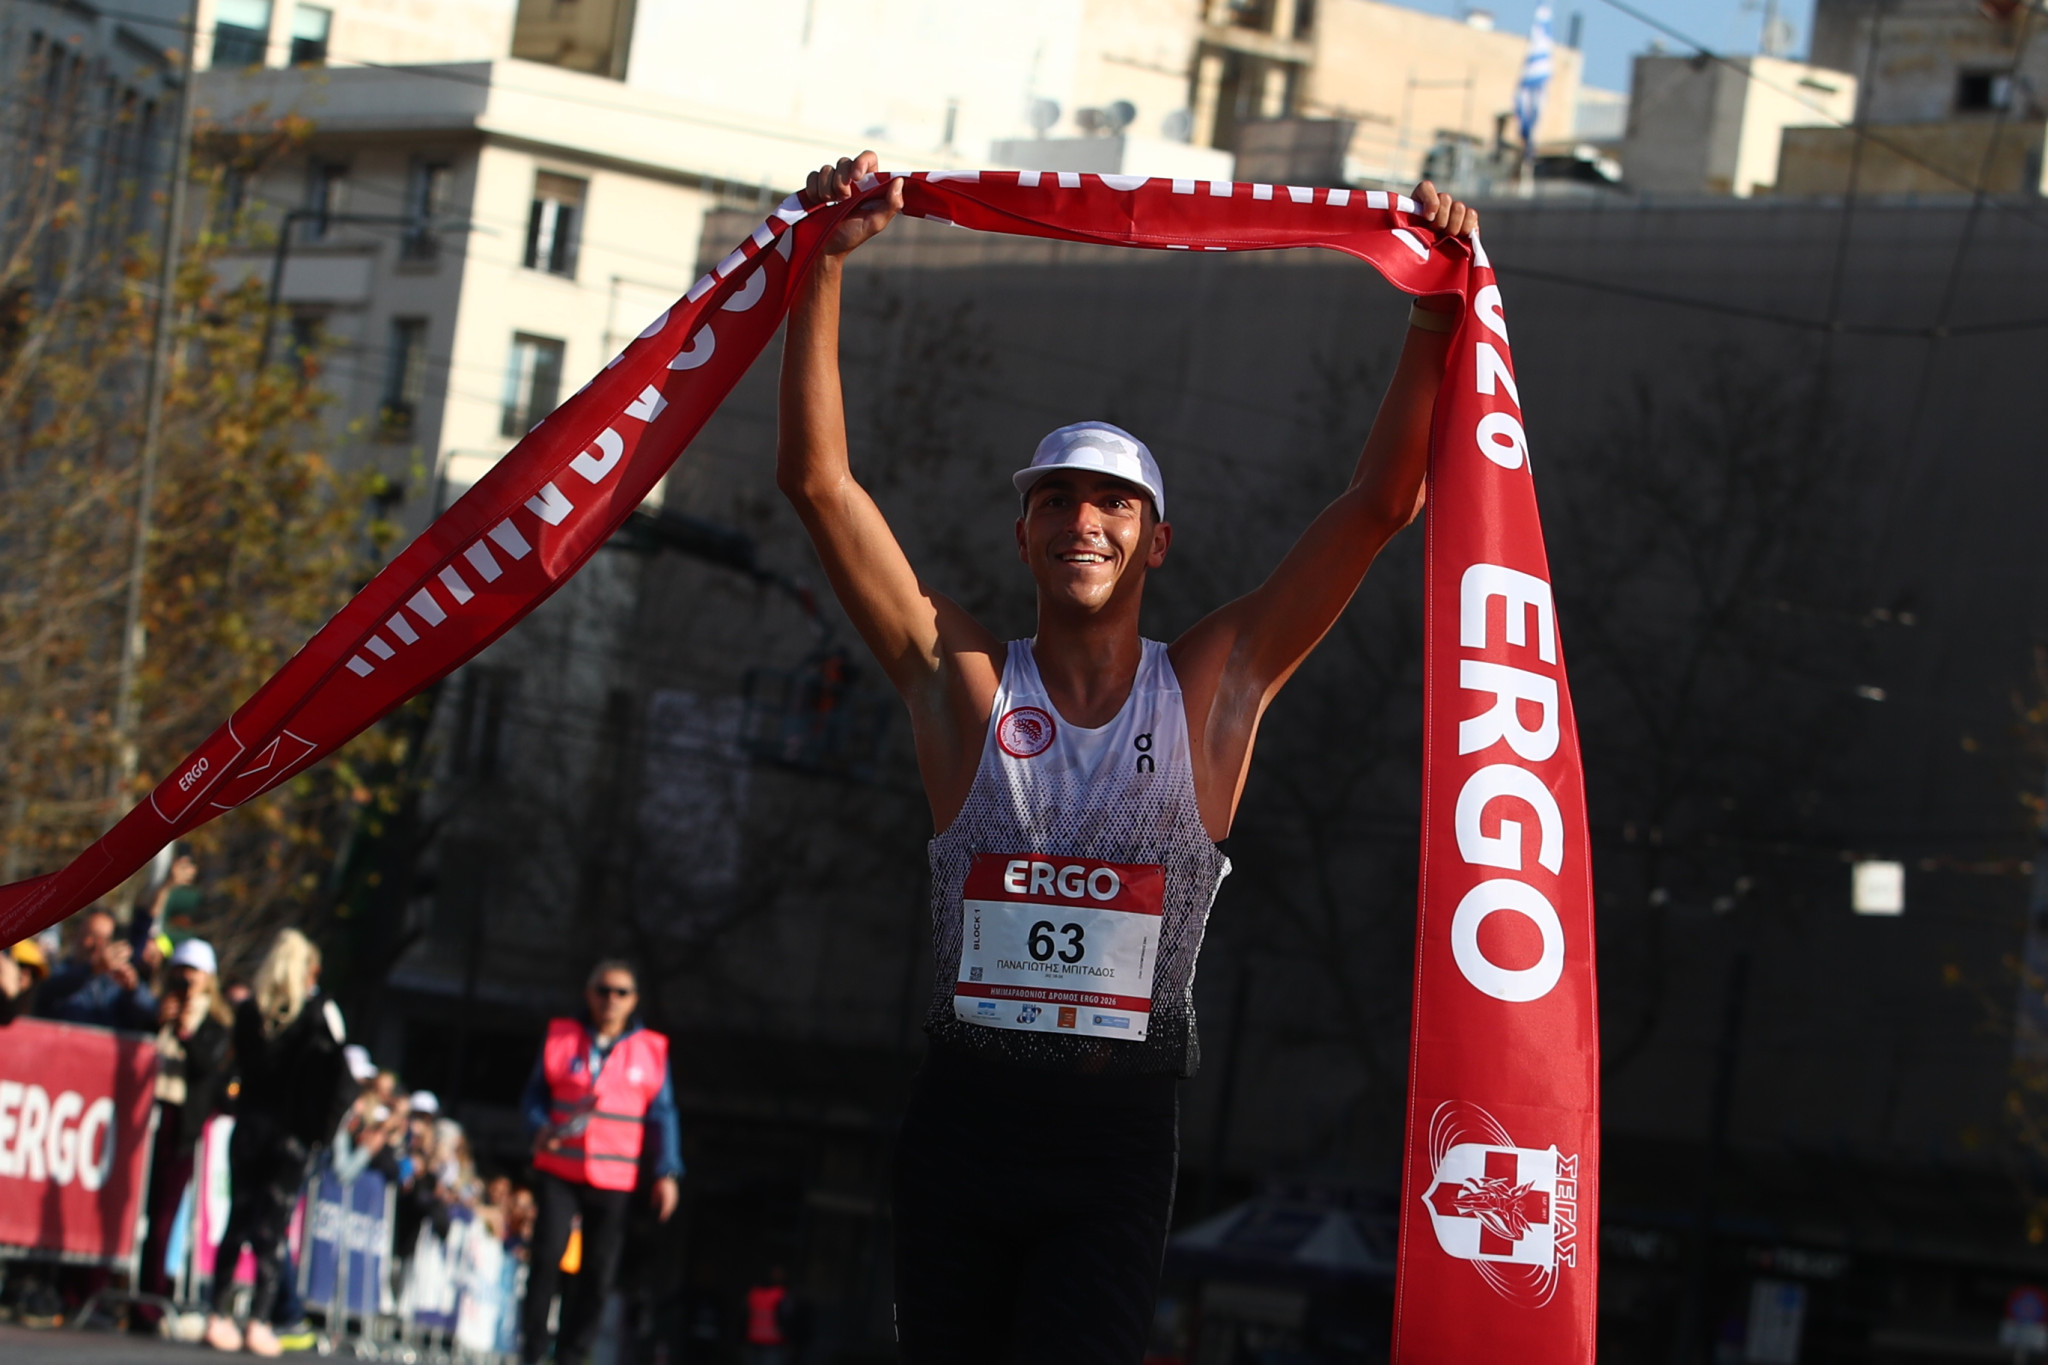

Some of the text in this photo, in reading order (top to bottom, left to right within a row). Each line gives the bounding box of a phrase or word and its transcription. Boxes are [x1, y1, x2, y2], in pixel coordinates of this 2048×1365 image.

[1450, 229, 1565, 1002] 026 ERGO
[178, 757, 209, 792] ERGO
[1004, 860, 1120, 901] ERGO
[973, 918, 981, 950] BLOCK
[1028, 920, 1085, 963] 63
[997, 959, 1059, 973] ΠΑΝΑΓΙΩΤΗΣ
[1062, 965, 1115, 977] ΜΠΙΤΑΔΟΣ
[1048, 993, 1078, 1002] ΔΡΟΜΟΣ
[1080, 994, 1099, 1004] ERGO
[1100, 996, 1117, 1005] 2026
[0, 1080, 116, 1191] ERGO
[1554, 1150, 1578, 1268] ΣΕΓΑΣ
